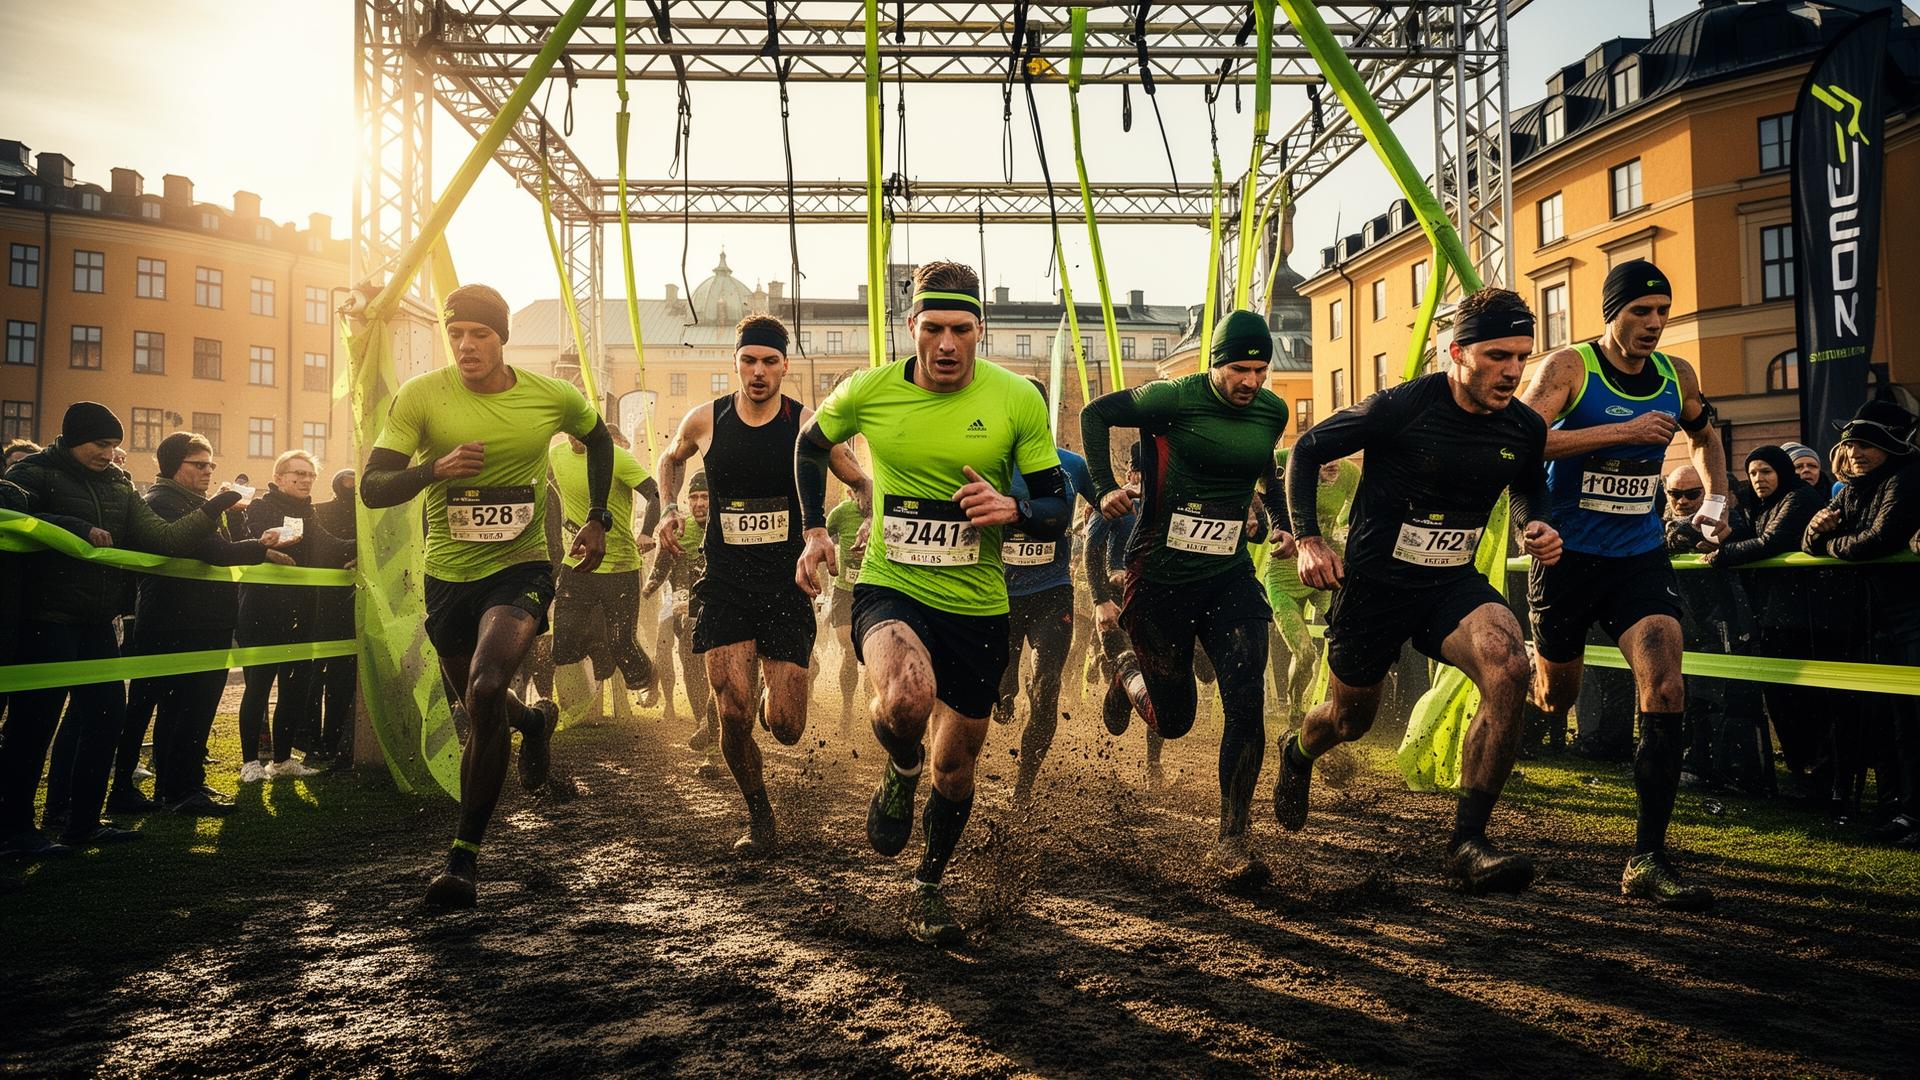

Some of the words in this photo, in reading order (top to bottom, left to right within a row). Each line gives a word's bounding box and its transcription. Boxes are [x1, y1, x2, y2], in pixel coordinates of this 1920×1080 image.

[472, 506, 513, 527] 528
[904, 520, 960, 547] 2441
[1189, 519, 1226, 541] 772
[1425, 531, 1465, 552] 762
